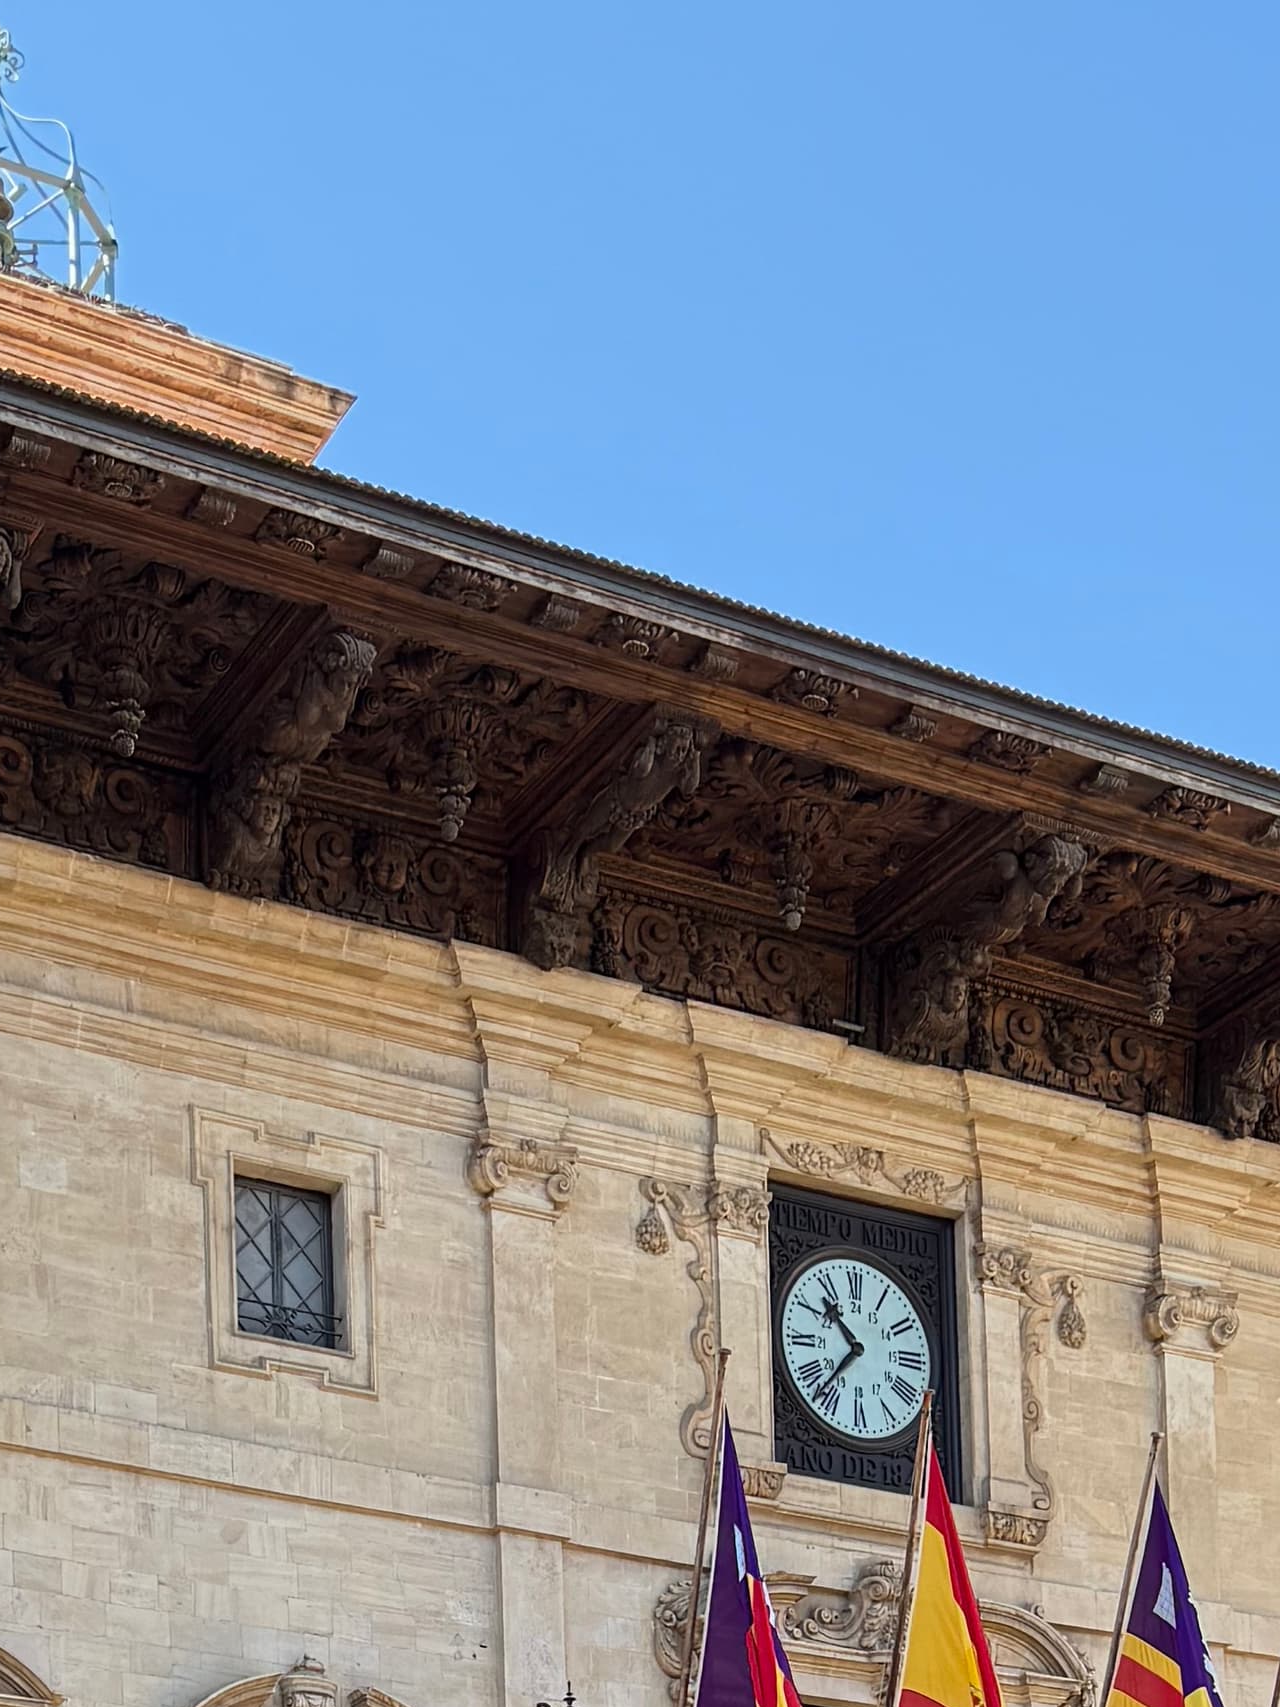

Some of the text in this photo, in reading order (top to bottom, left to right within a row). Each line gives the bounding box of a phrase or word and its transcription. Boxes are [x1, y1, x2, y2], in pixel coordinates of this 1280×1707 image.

[775, 1201, 852, 1241] TIEMPO
[850, 1301, 862, 1315] 24
[868, 1312, 879, 1325] 13
[881, 1328, 891, 1342] 14
[816, 1336, 826, 1350] 21
[823, 1358, 835, 1371] 20
[888, 1351, 898, 1364] 15
[884, 1370, 894, 1384] 16
[854, 1386, 864, 1399] 18
[872, 1383, 881, 1396] 17
[842, 1453, 878, 1483] DE
